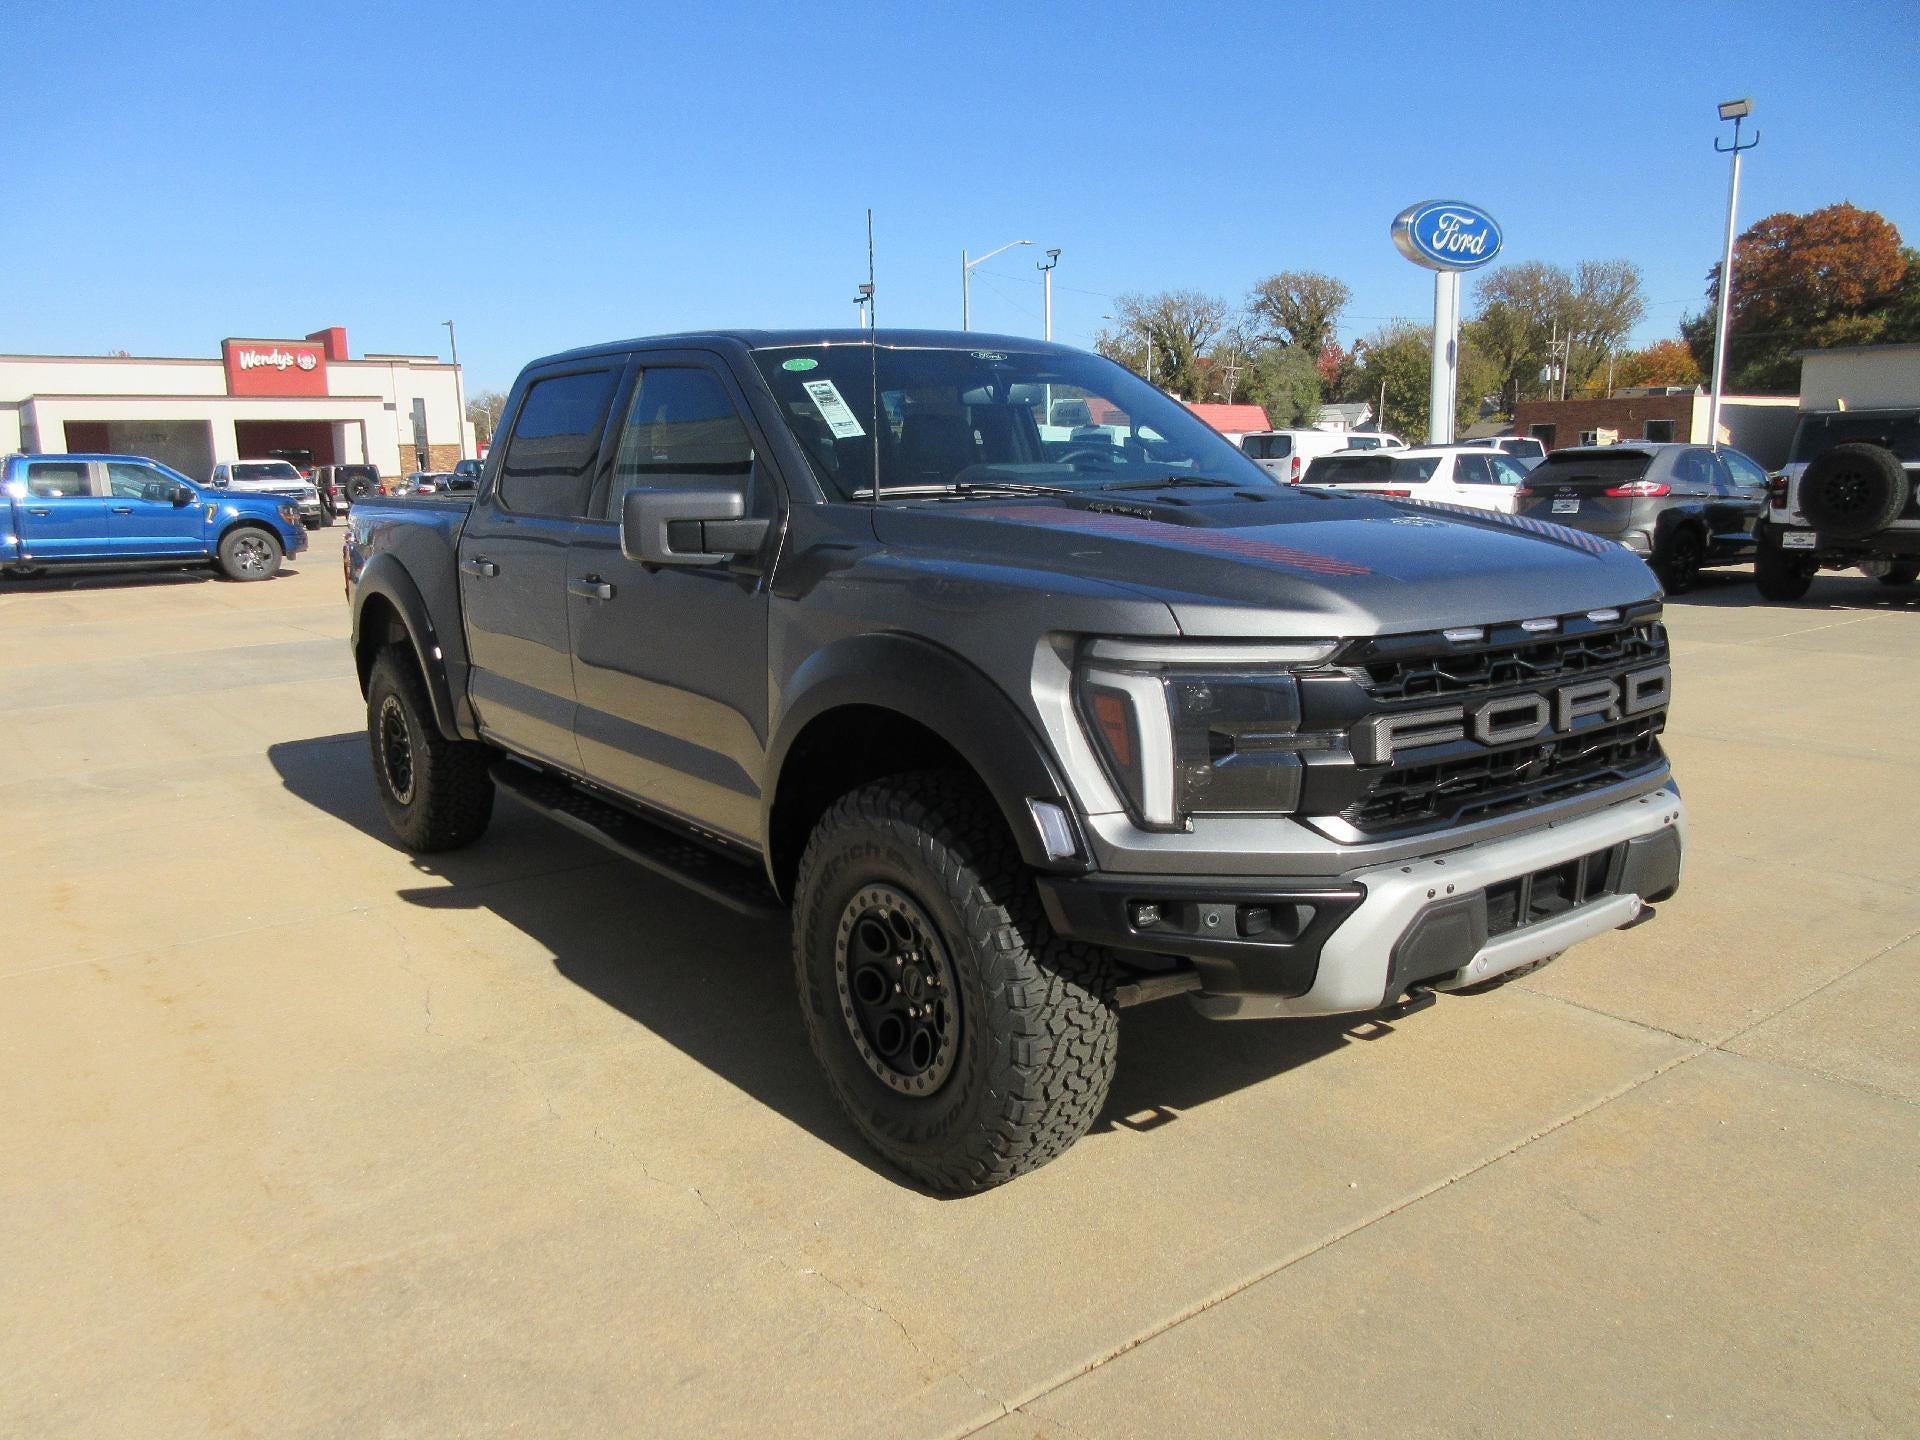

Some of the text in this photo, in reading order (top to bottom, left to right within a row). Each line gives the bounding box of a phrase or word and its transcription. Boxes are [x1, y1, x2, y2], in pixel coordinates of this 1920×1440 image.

[1432, 213, 1488, 255] Ford
[239, 348, 294, 371] Wendy's
[1366, 664, 1672, 764] FORD
